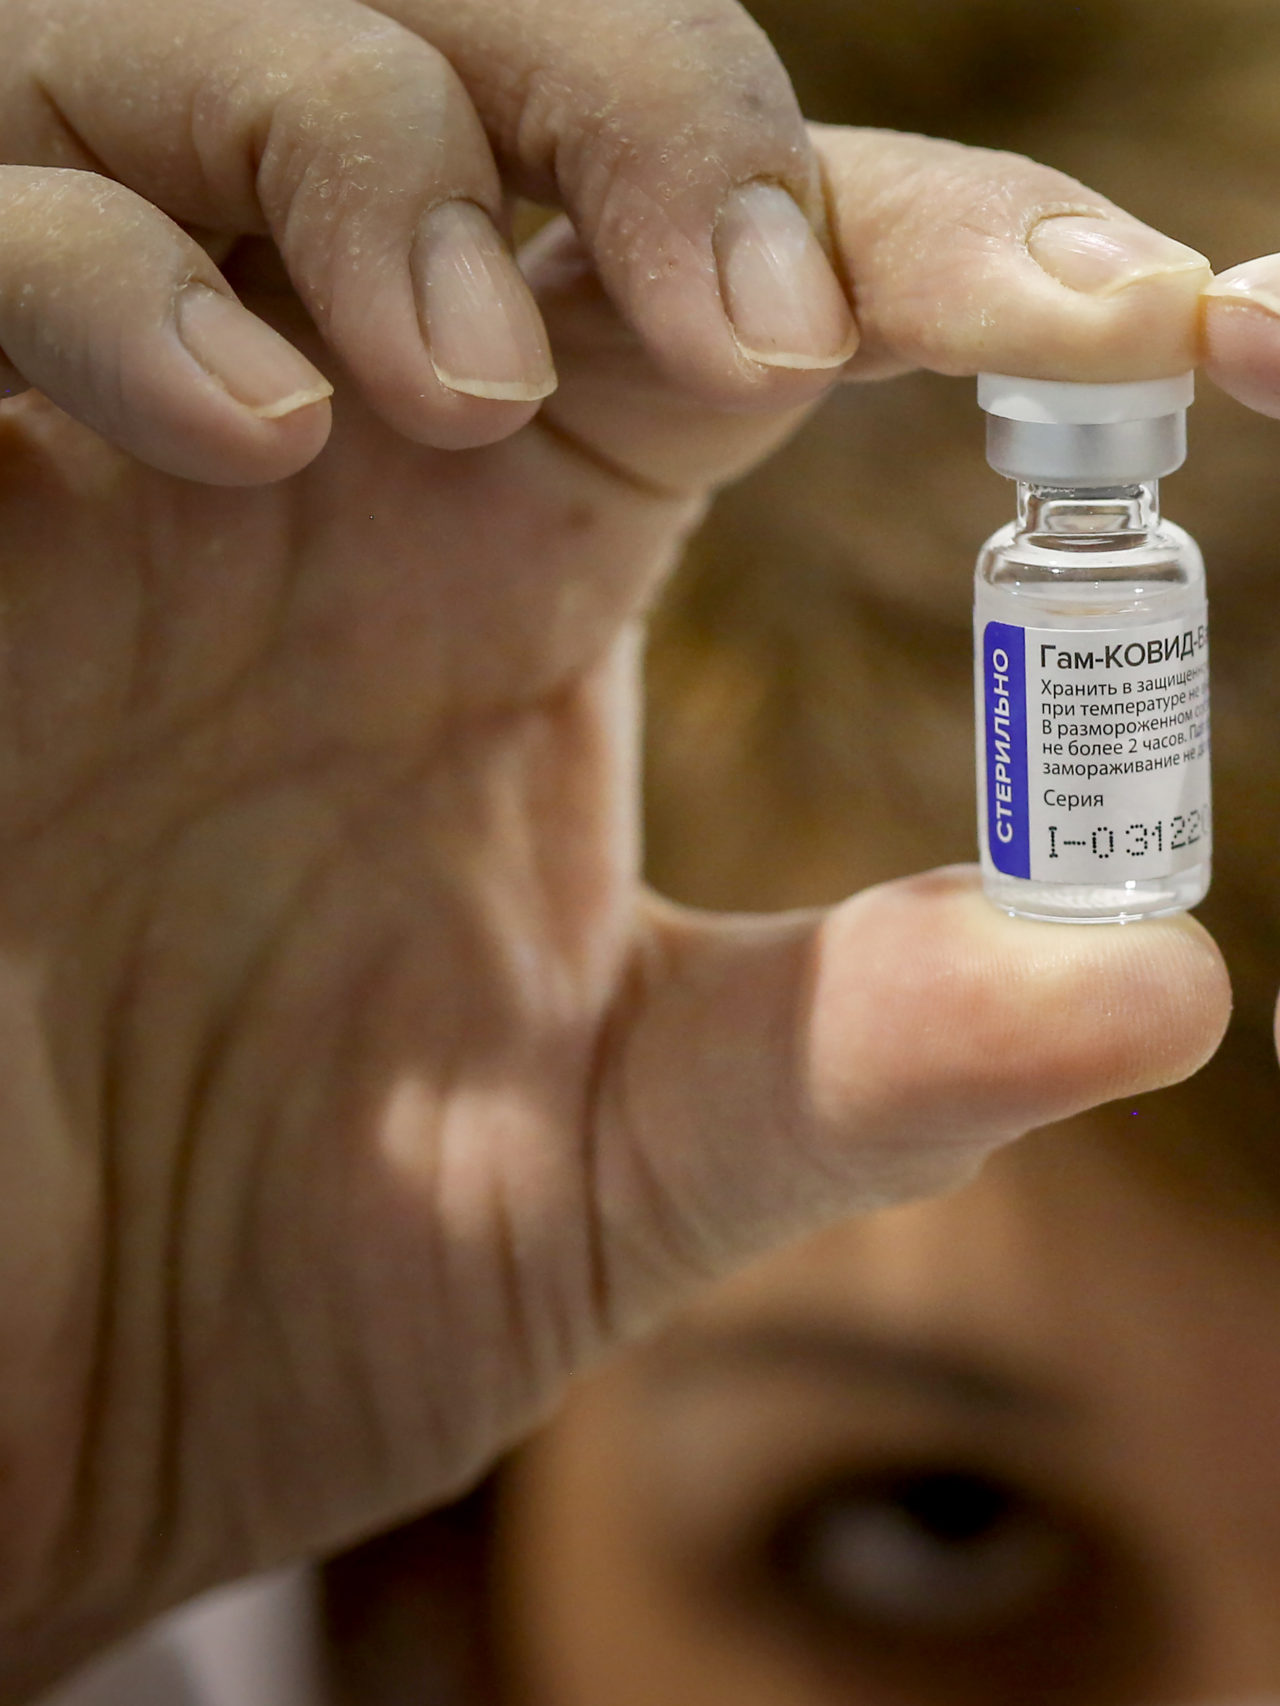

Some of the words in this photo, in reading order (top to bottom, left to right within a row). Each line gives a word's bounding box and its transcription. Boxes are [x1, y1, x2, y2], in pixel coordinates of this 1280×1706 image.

[1041, 680, 1118, 699] Хранить
[1122, 682, 1132, 694] в
[1136, 667, 1205, 693] защищен
[1042, 704, 1076, 719] при
[1080, 692, 1186, 716] температуре
[1042, 719, 1052, 735] В
[1057, 709, 1193, 739] размороженном
[993, 648, 1013, 843] СТЕРИЛЬНО
[1043, 742, 1063, 756] не
[1068, 740, 1123, 756] более
[1128, 739, 1137, 754] 2
[1142, 732, 1187, 750] часов.
[1043, 753, 1180, 779] замораживание
[1043, 789, 1104, 811] Серия
